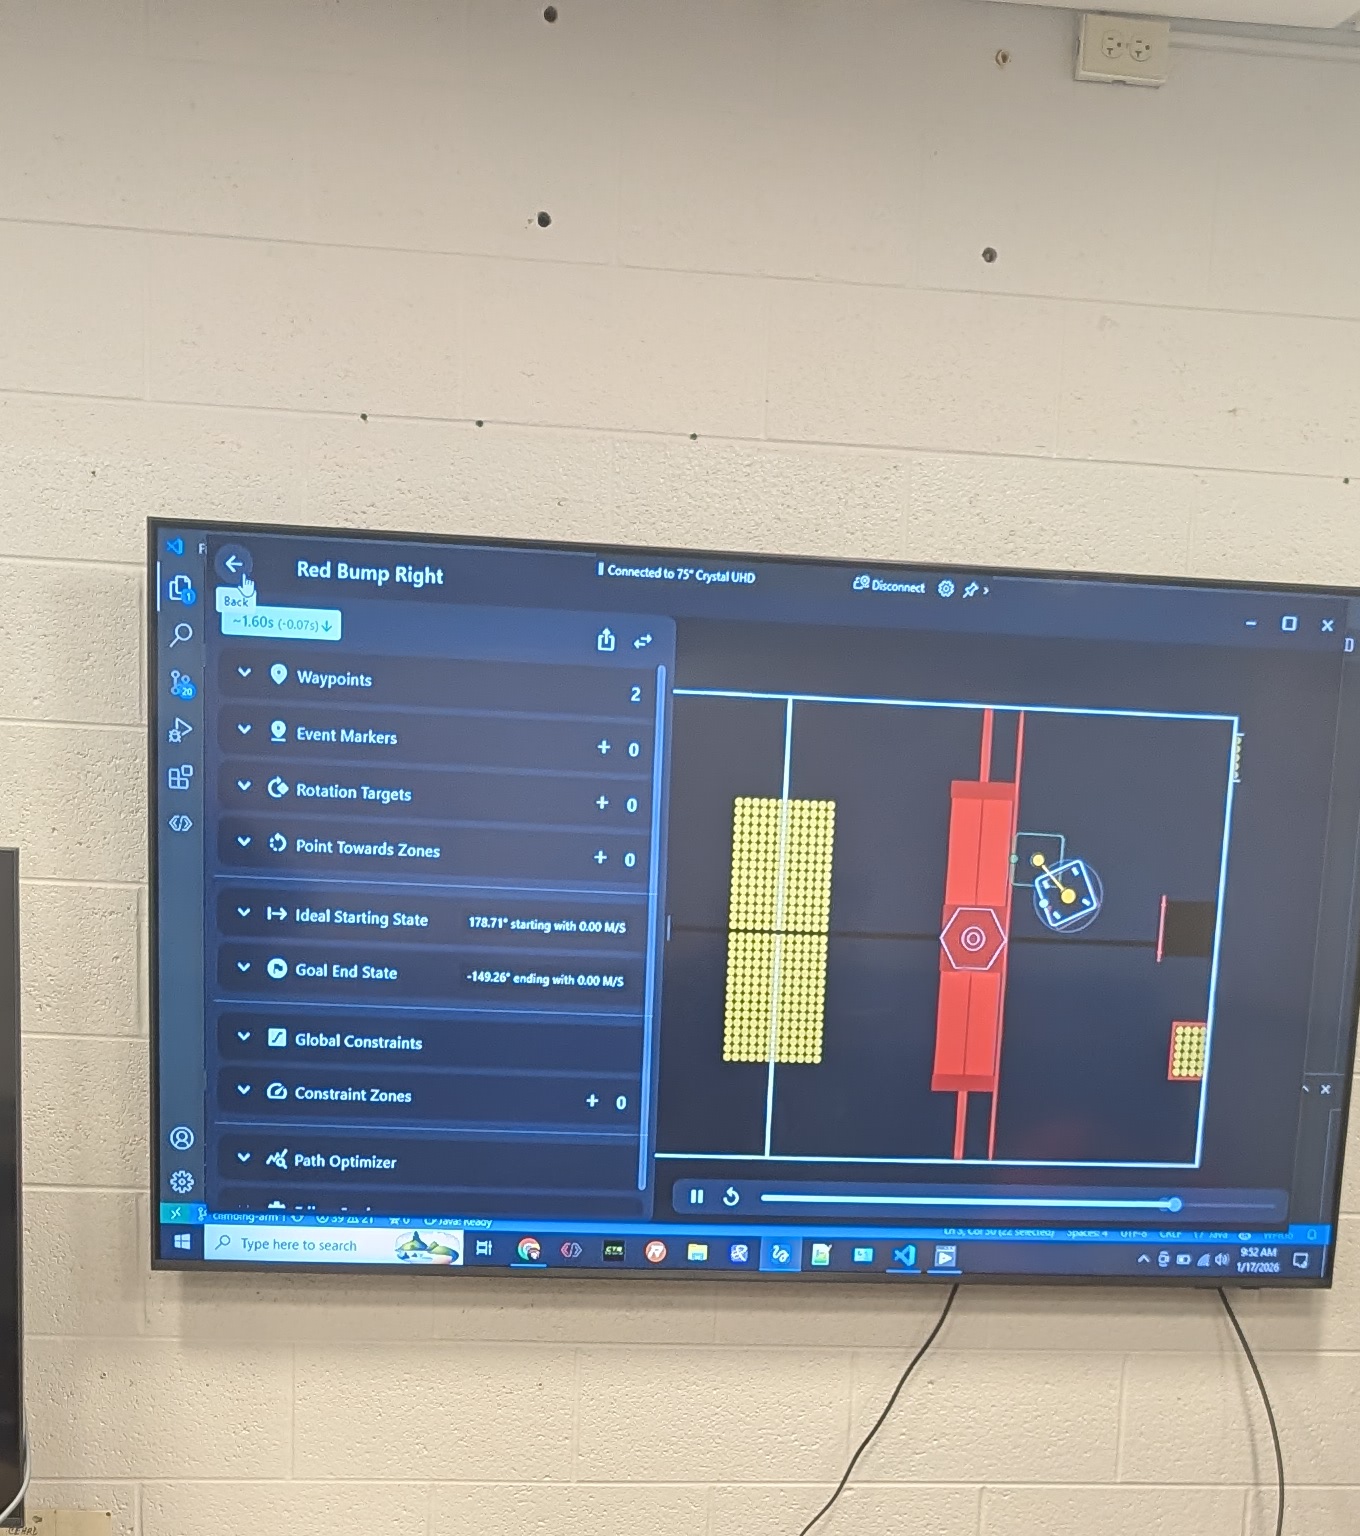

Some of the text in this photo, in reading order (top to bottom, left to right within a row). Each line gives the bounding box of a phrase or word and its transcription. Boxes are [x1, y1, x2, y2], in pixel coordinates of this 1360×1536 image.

[297, 561, 444, 586] Red Bump Right
[608, 565, 755, 584] Connected to 75" Crystal UHD
[872, 579, 925, 594] Disconnect
[224, 596, 248, 608] Back
[233, 614, 318, 633] ~1.60s (-0.07s)
[297, 670, 372, 690] Waypoints
[630, 688, 640, 702] 2
[297, 726, 397, 745] Event Markers
[629, 743, 638, 756] 0
[296, 784, 412, 804] Rotation Targets
[627, 799, 637, 812] 0
[296, 838, 440, 858] Point Towards Zones
[624, 853, 635, 867] 0
[295, 909, 428, 929] Ideal Starting State
[469, 917, 626, 934] 178.71° starting with 0.00 M/S
[295, 963, 398, 980] Goal End State
[467, 971, 624, 988] -149.26° ending with 0.00 M/S
[295, 1032, 423, 1051] Global Constraints
[295, 1087, 412, 1104] Constraint Zones
[616, 1096, 627, 1109] 0
[295, 1154, 397, 1173] Path Optimizer
[242, 1238, 356, 1252] Type here to search
[1241, 1248, 1277, 1258] 9:52 AM
[1237, 1262, 1279, 1272] 1/17/2026
